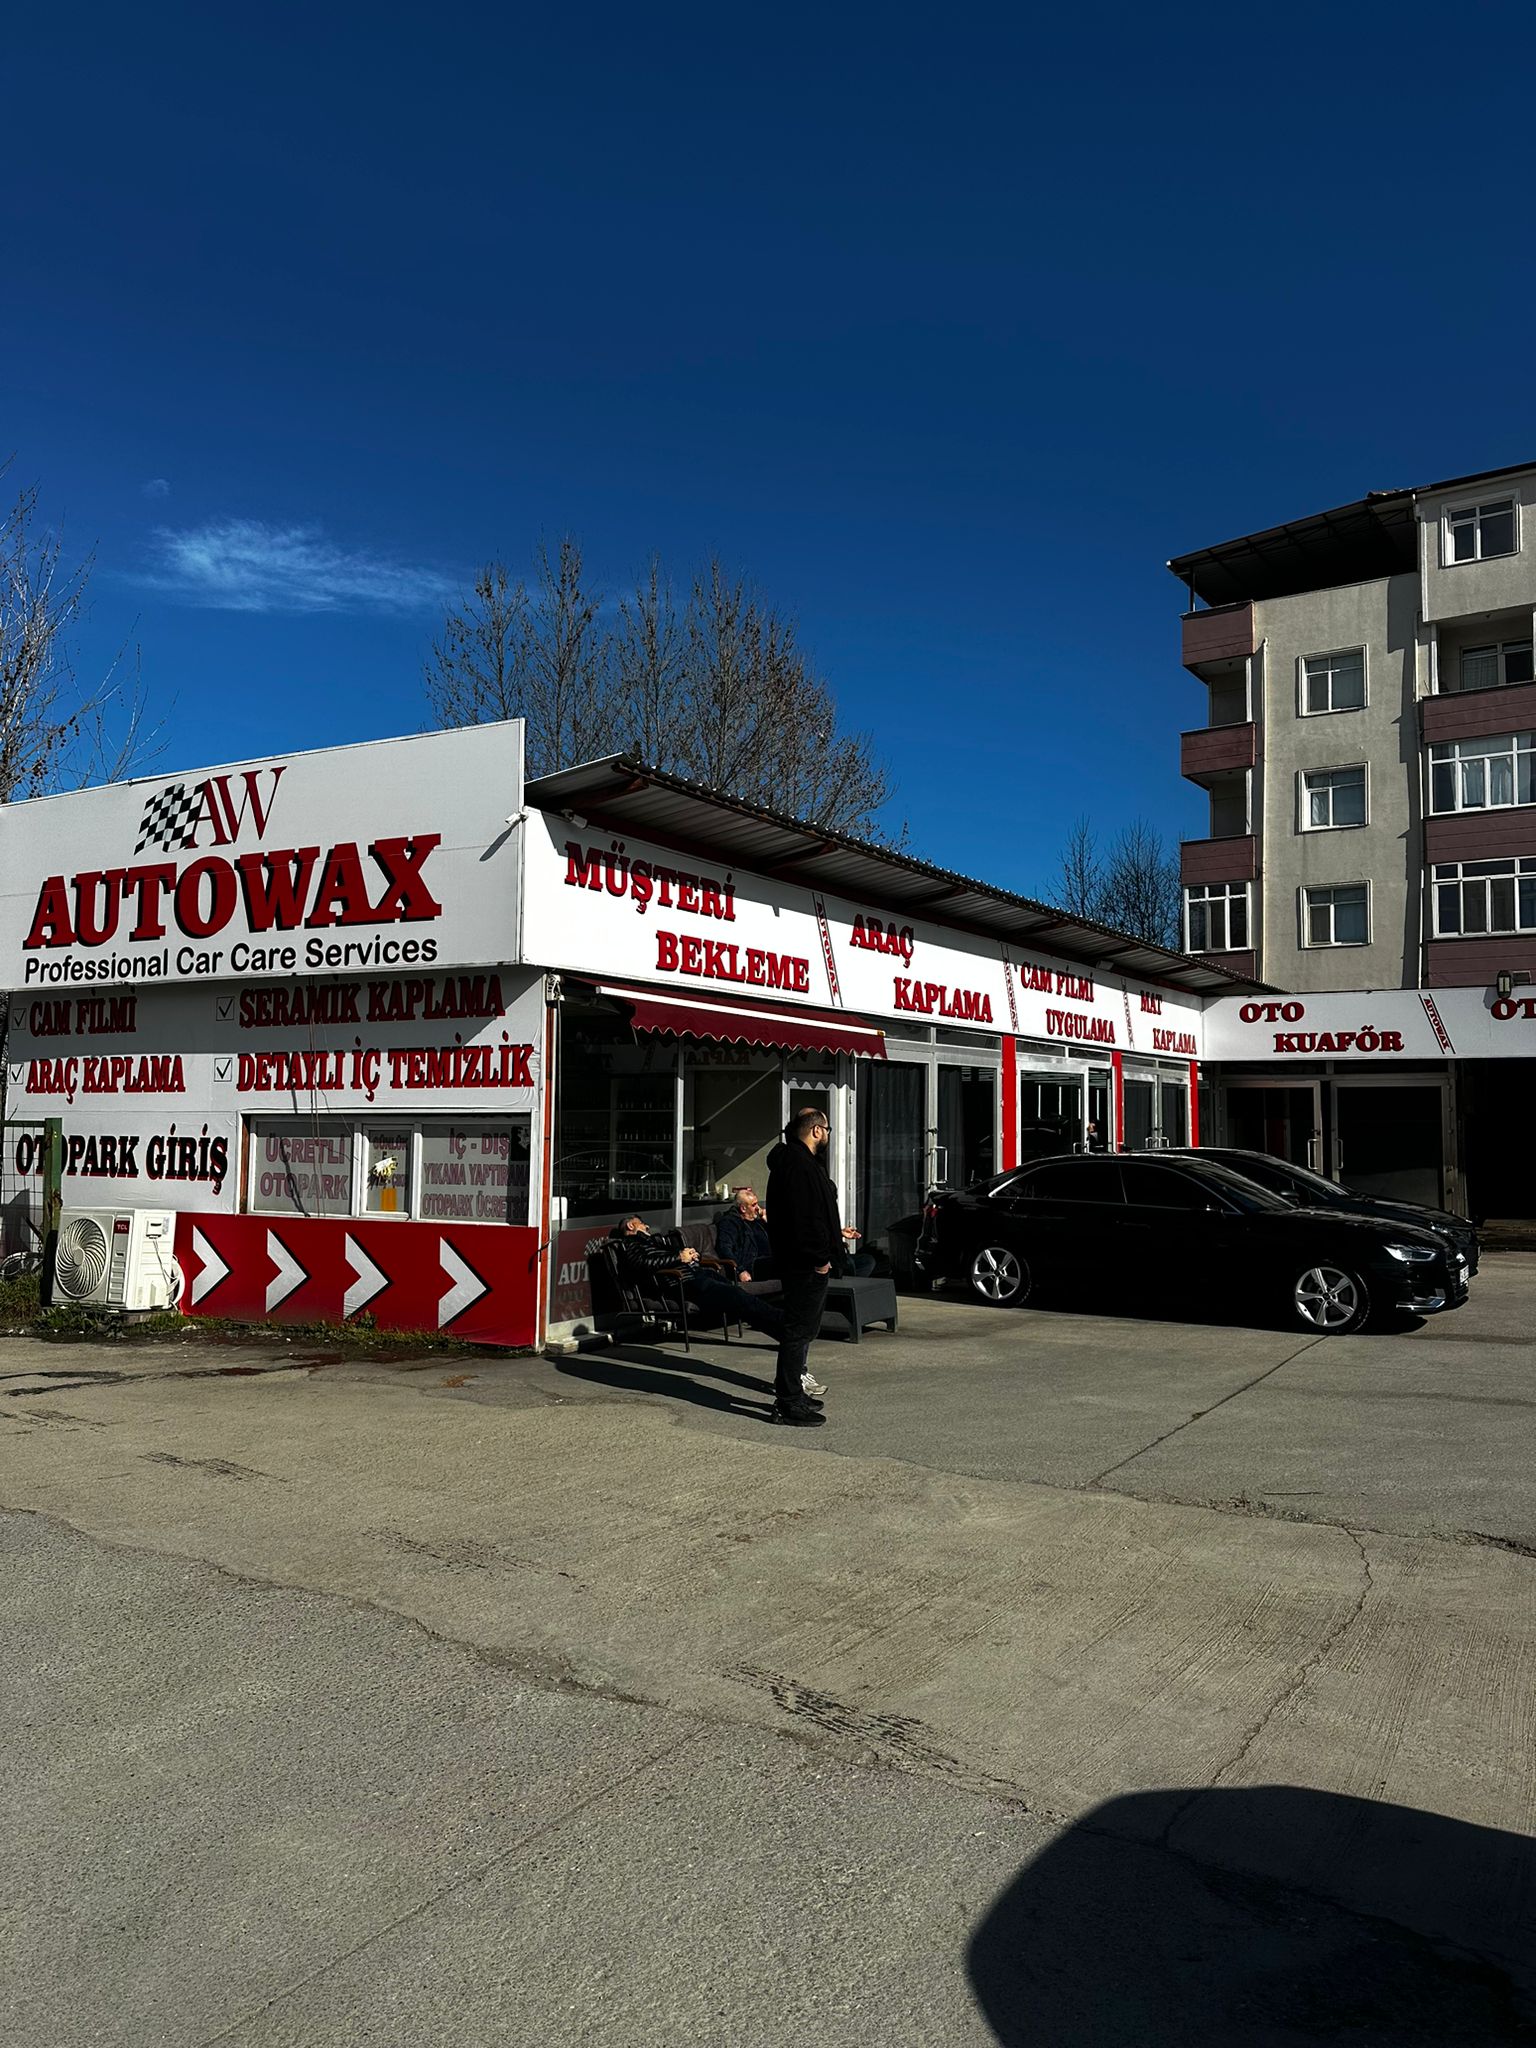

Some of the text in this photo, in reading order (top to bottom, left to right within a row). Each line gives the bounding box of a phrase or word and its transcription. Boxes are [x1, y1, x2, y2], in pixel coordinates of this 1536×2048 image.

[188, 766, 287, 848] AW
[22, 833, 442, 950] AUTOWAX
[564, 840, 736, 921] MÜŞTERİ
[24, 934, 439, 984] Professional Car Care Services
[655, 930, 810, 993] BEKLEME
[849, 913, 915, 967] ARAÇ
[239, 974, 506, 1028] SERAMİK KAPLAMA
[893, 976, 994, 1023] KAPLAMA
[1020, 961, 1095, 1003] CAM FİLMİ
[1140, 989, 1162, 1015] MAT
[29, 986, 138, 1037] CAM FİLMİ
[1045, 1008, 1116, 1044] UYGULAMA
[1238, 1002, 1305, 1023] OTO
[1424, 998, 1450, 1050] AUTOWAX
[1153, 1027, 1197, 1055] KAPLAMA
[1273, 1025, 1404, 1053] KUAFÖR
[25, 1055, 186, 1104] ARAÇ KAPLAMA
[236, 1030, 536, 1103] DETAYLI İÇ TEMİZLİK
[15, 1123, 229, 1195] OTPARK GİRİŞ
[265, 1132, 345, 1164] ÜCRETLİ
[449, 1127, 467, 1160] İÇ
[480, 1132, 511, 1160] DIŞ
[260, 1172, 349, 1200] OTOPARK
[423, 1163, 467, 1186] YIKAMA
[422, 1193, 474, 1217] OTOPARK
